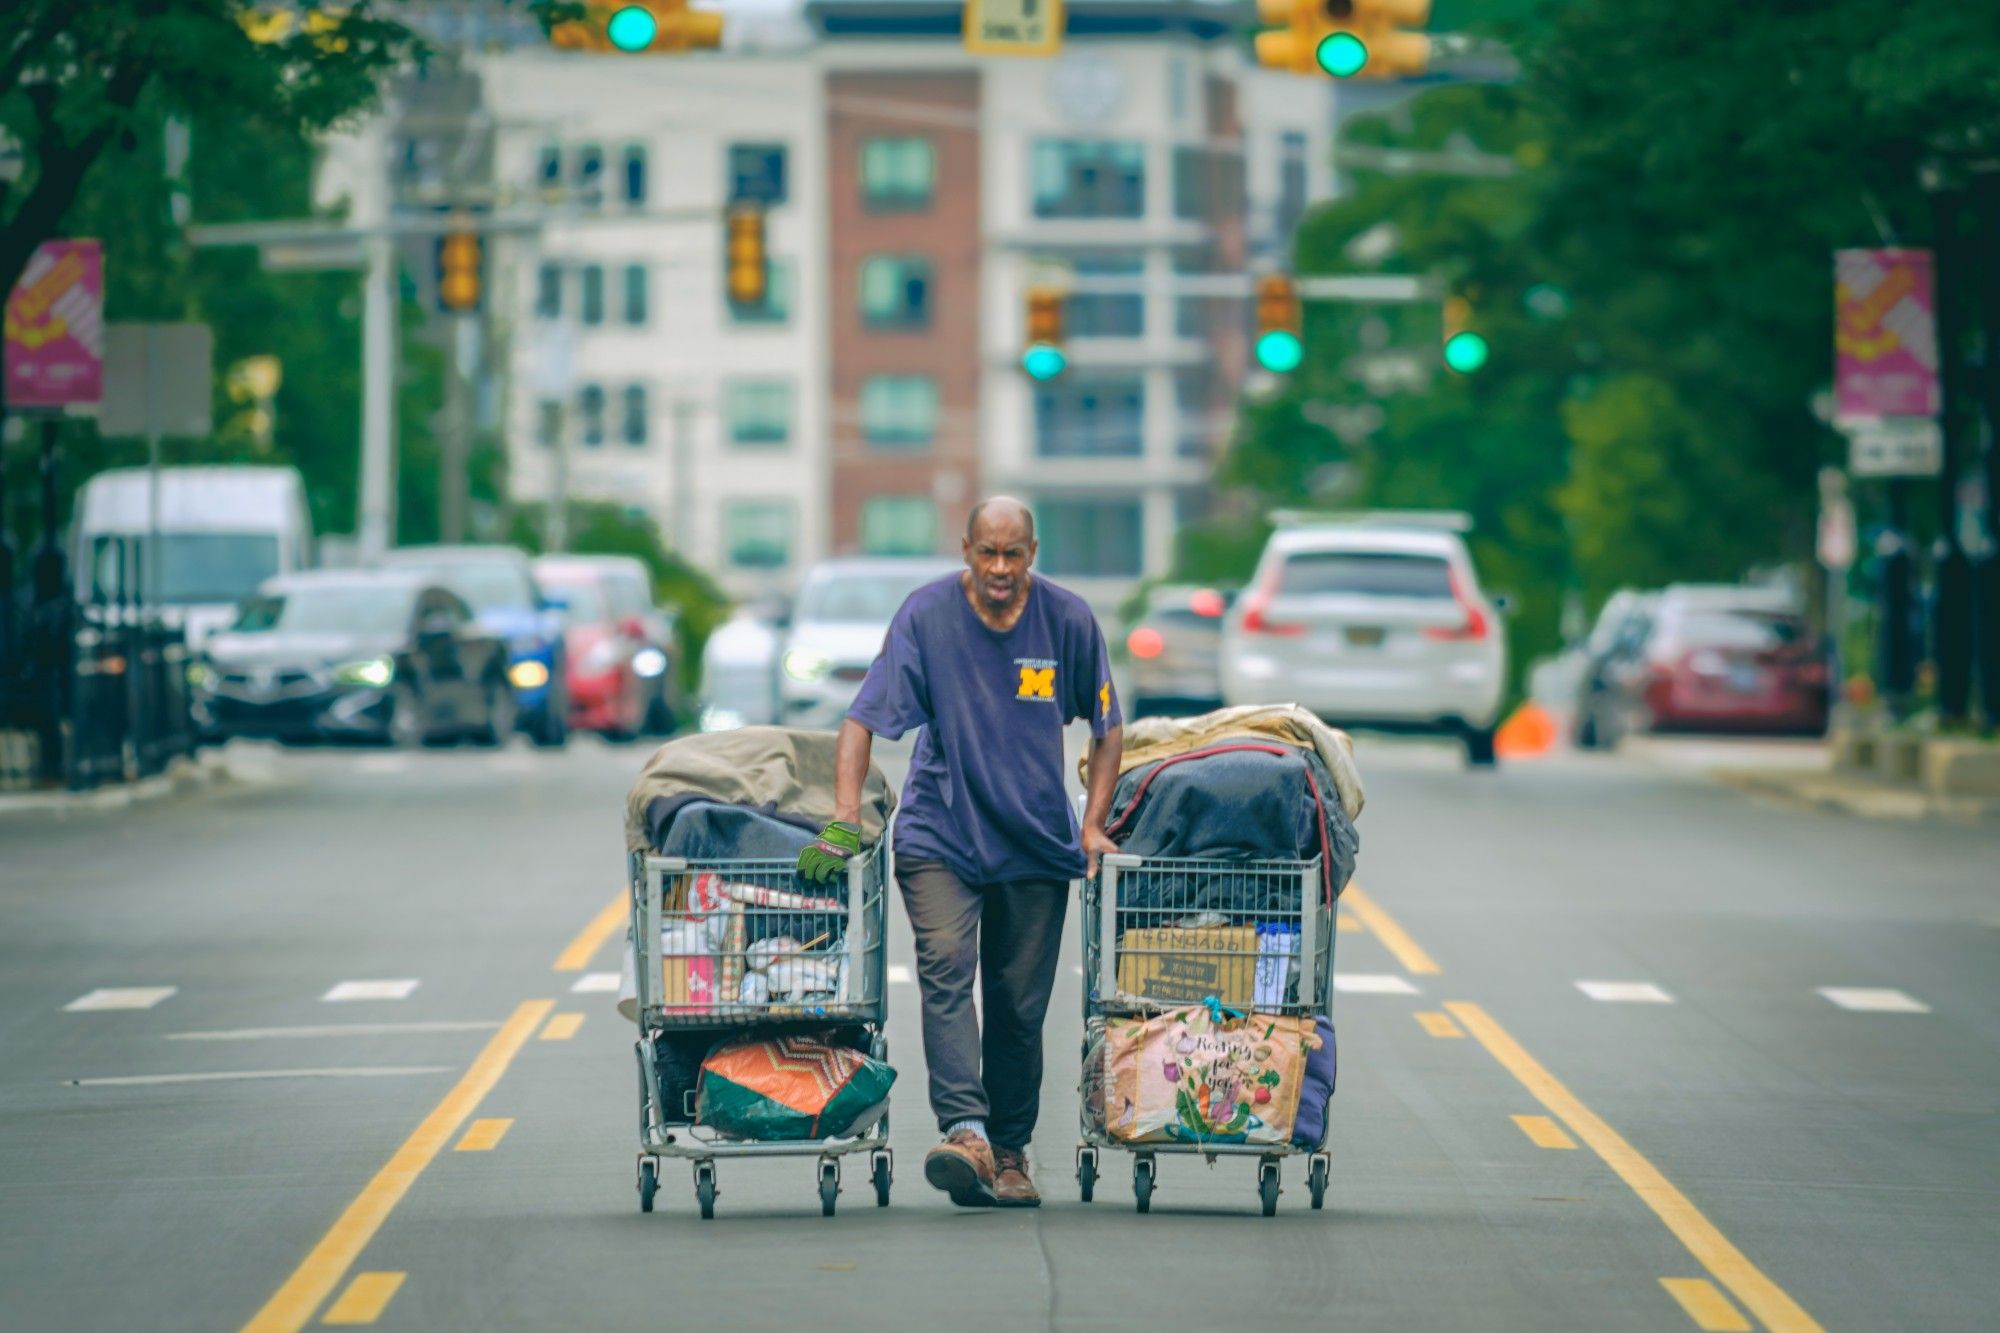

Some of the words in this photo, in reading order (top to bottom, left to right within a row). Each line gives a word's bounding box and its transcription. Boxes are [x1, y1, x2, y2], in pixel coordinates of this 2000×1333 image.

[1018, 667, 1056, 697] M
[1196, 1036, 1252, 1061] Rooting
[1212, 1059, 1233, 1075] for
